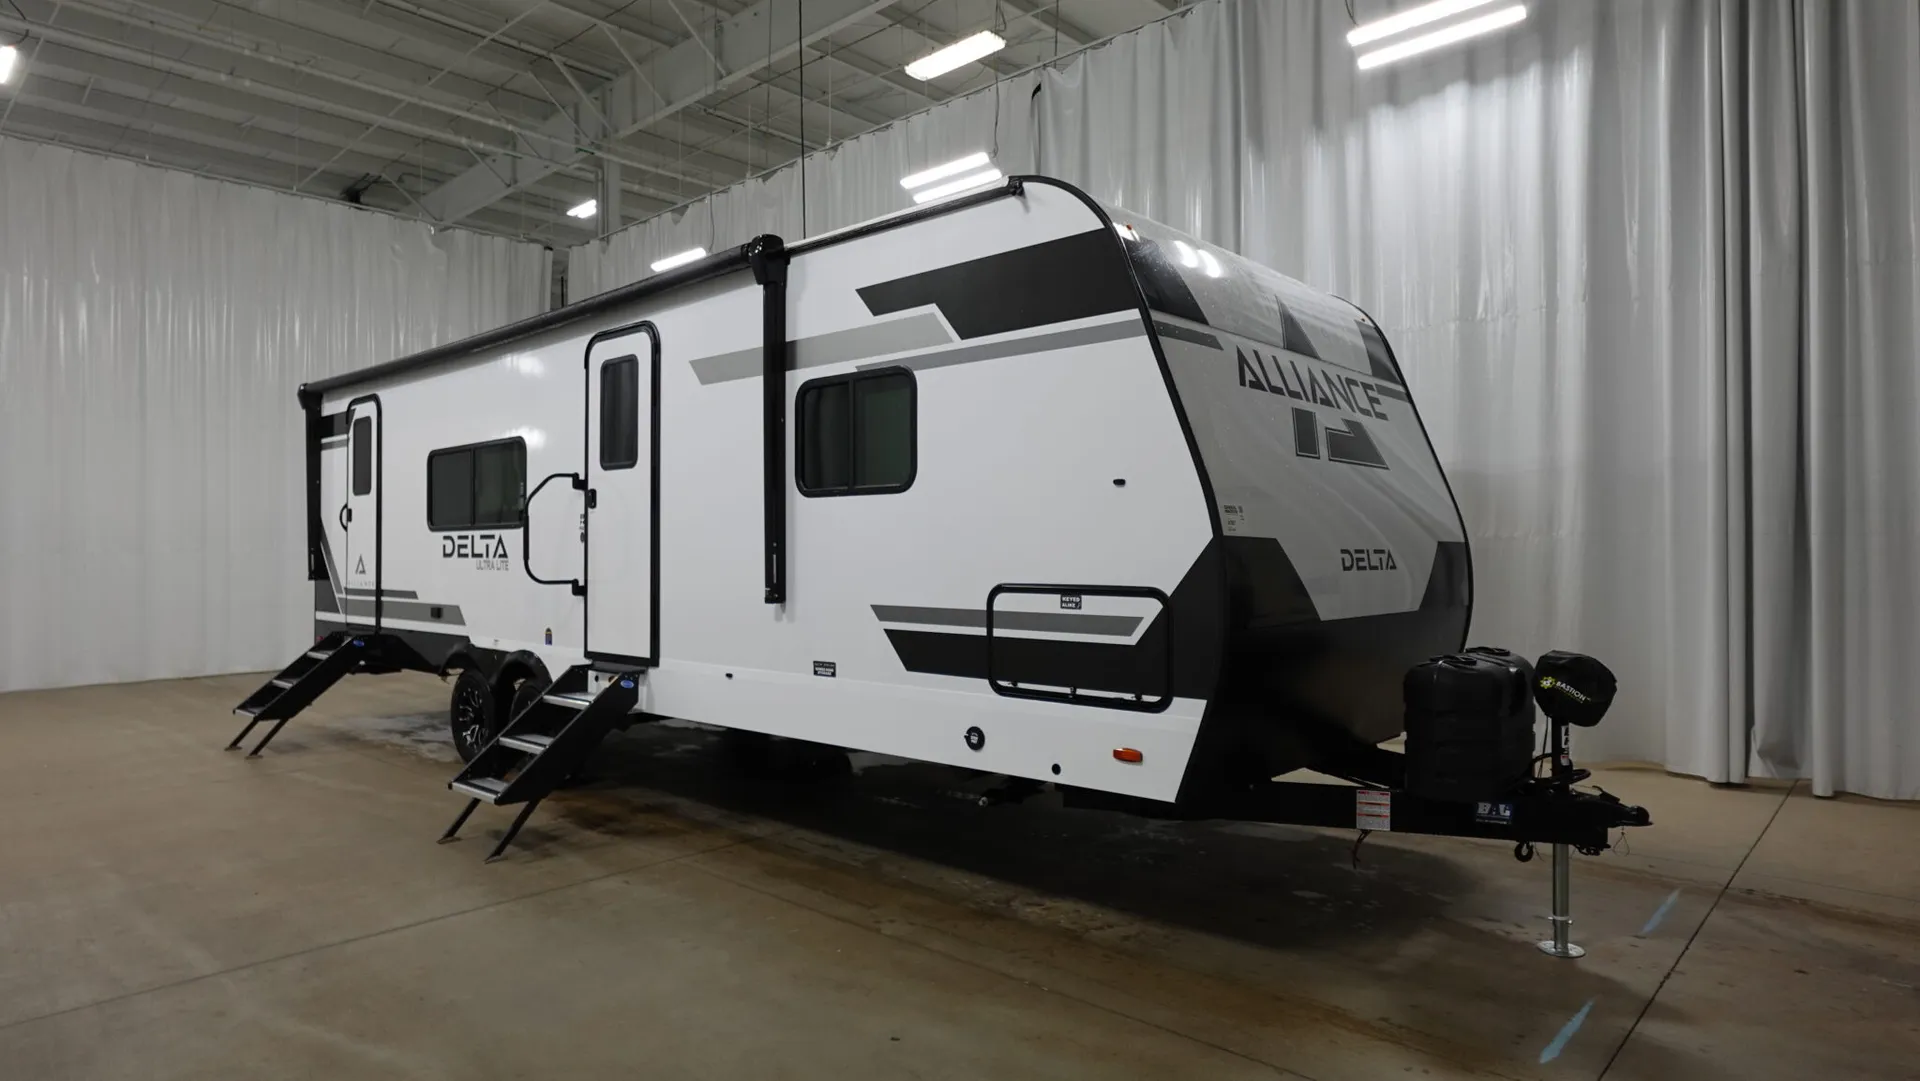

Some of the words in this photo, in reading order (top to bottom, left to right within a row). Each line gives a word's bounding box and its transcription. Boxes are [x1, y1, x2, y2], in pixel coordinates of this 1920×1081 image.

[1236, 344, 1389, 421] ALLIANCE
[443, 534, 508, 558] DELTA
[476, 559, 495, 571] ULTRA
[496, 559, 509, 571] LITE
[1340, 549, 1397, 571] DELTA
[1556, 681, 1587, 701] BASTION
[1478, 802, 1510, 816] BL
